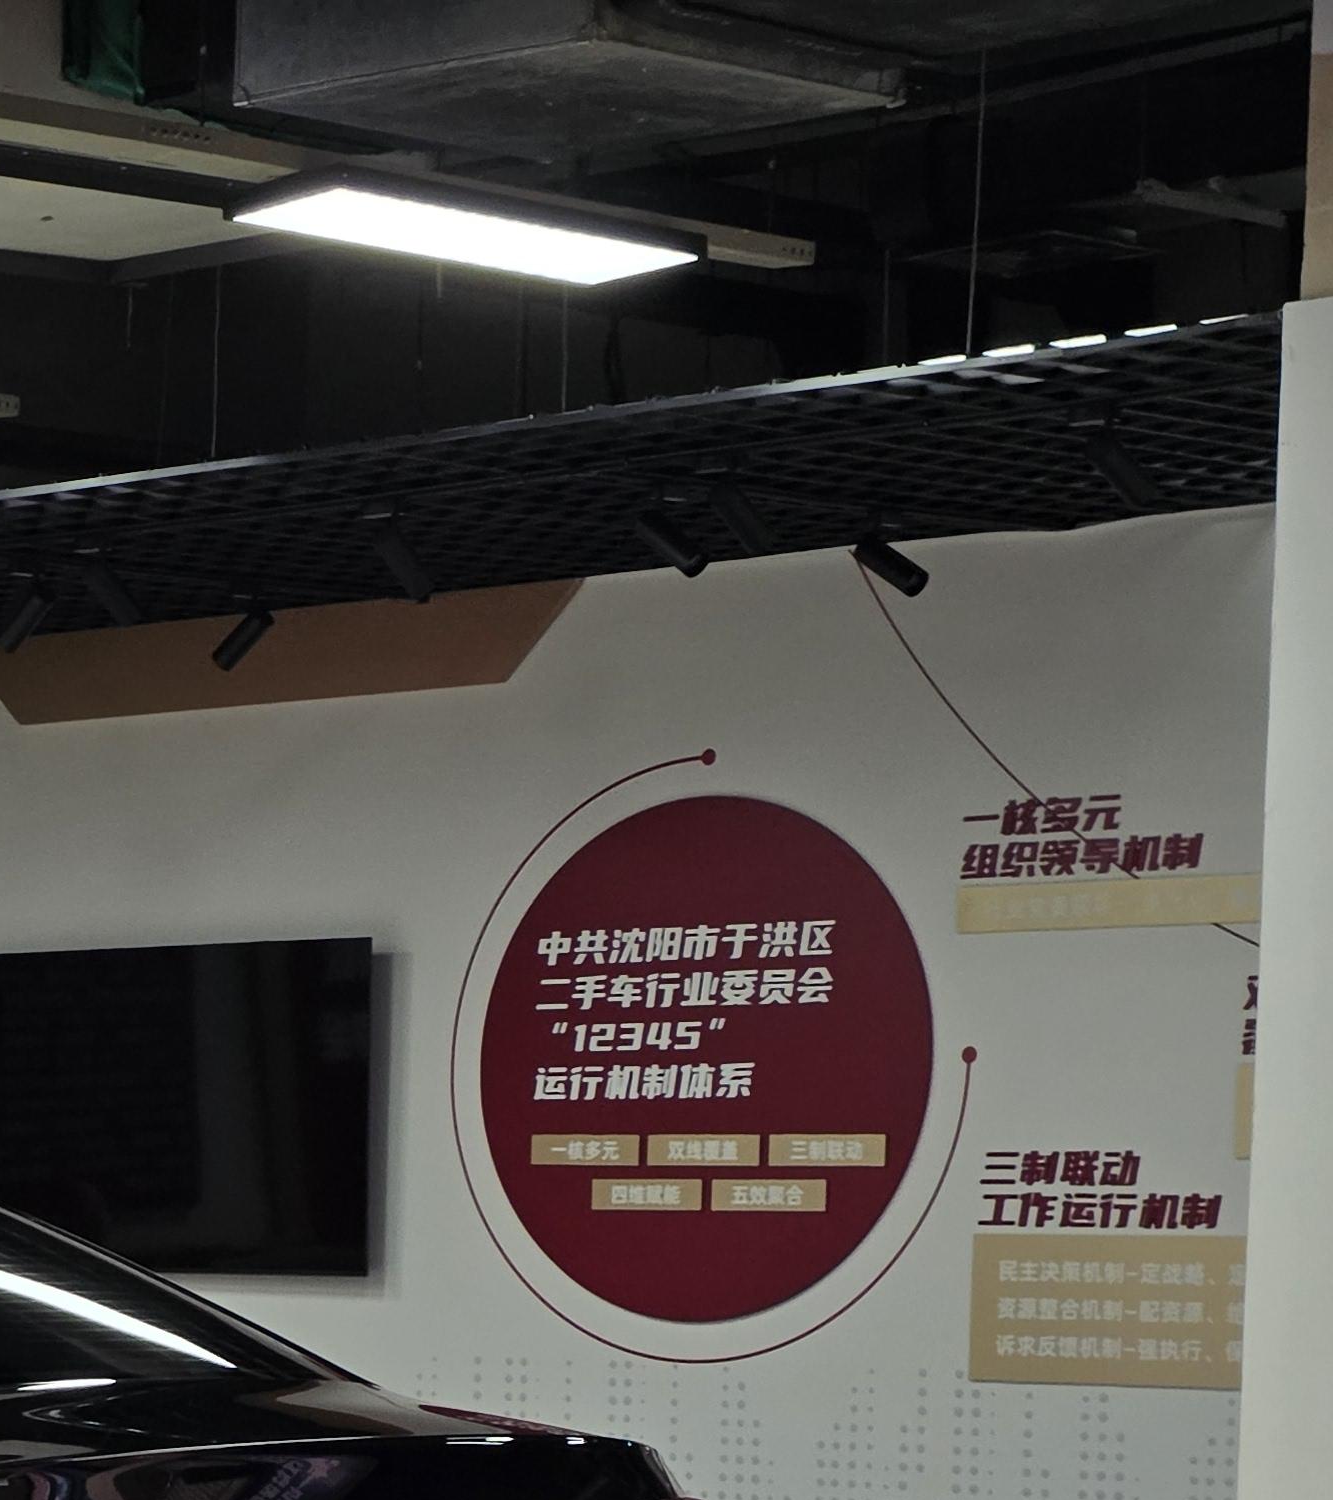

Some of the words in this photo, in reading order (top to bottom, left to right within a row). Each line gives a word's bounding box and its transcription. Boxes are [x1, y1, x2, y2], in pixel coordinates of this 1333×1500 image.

[963, 794, 1122, 836] 一核多元
[960, 833, 1204, 880] 组织领导机制
[536, 919, 837, 963] 中共沈阳市于洪区
[534, 966, 836, 1013] 二手车行业委员会
[533, 1061, 757, 1101] 运行机制体系
[550, 1140, 620, 1161] 一核多元
[668, 1140, 738, 1162] 双线覆盖
[790, 1140, 863, 1161] 三制联动
[979, 1150, 1141, 1187] 三制联动
[611, 1184, 681, 1205] 四维赋能
[732, 1184, 804, 1205] 五效聚合
[978, 1192, 1224, 1229] 工作运行机制
